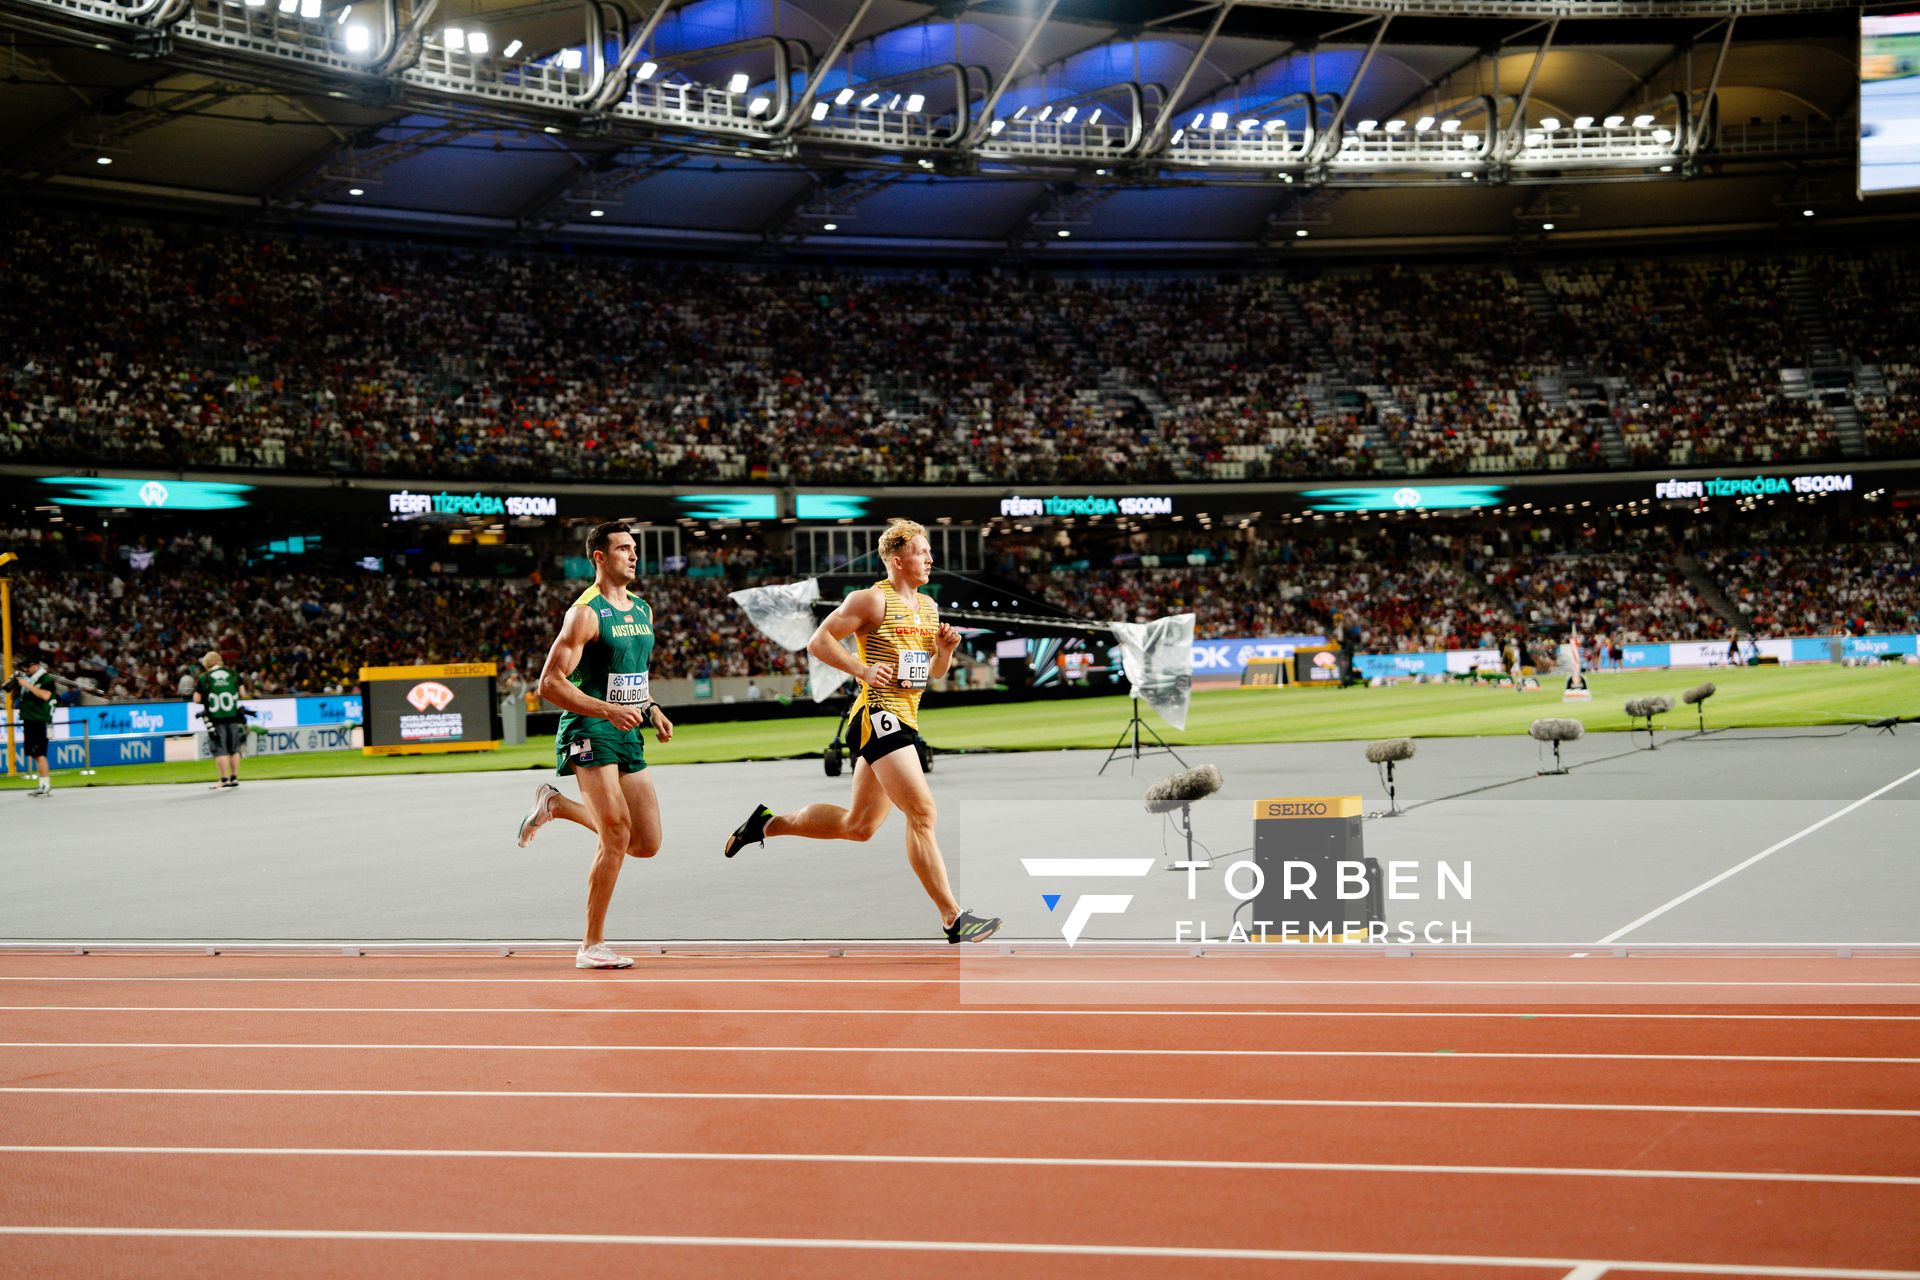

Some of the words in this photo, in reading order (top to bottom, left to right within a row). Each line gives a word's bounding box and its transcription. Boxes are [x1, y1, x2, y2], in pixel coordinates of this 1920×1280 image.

[1656, 478, 1702, 499] FÉRFI
[1704, 475, 1790, 497] TÍZPRÓBA
[1791, 474, 1853, 493] 1500M
[390, 490, 431, 513] FÉRFI
[432, 491, 505, 515] TÍZPRÓBA
[505, 496, 557, 516] 1500M
[1000, 495, 1043, 516] FÉRFI
[1043, 495, 1118, 515] TÍZPRÓBA
[1118, 497, 1172, 515] 1500M
[611, 623, 652, 637] AUSTRALIA
[1852, 640, 1889, 654] Tokyo
[1189, 645, 1232, 670] DK
[444, 664, 487, 675] SEIKO
[129, 710, 164, 732] Tokyo
[880, 714, 892, 731] 6
[266, 732, 300, 751] TDK
[317, 729, 349, 748] TDK
[120, 740, 152, 760] NTN
[1268, 803, 1327, 817] SEIKO
